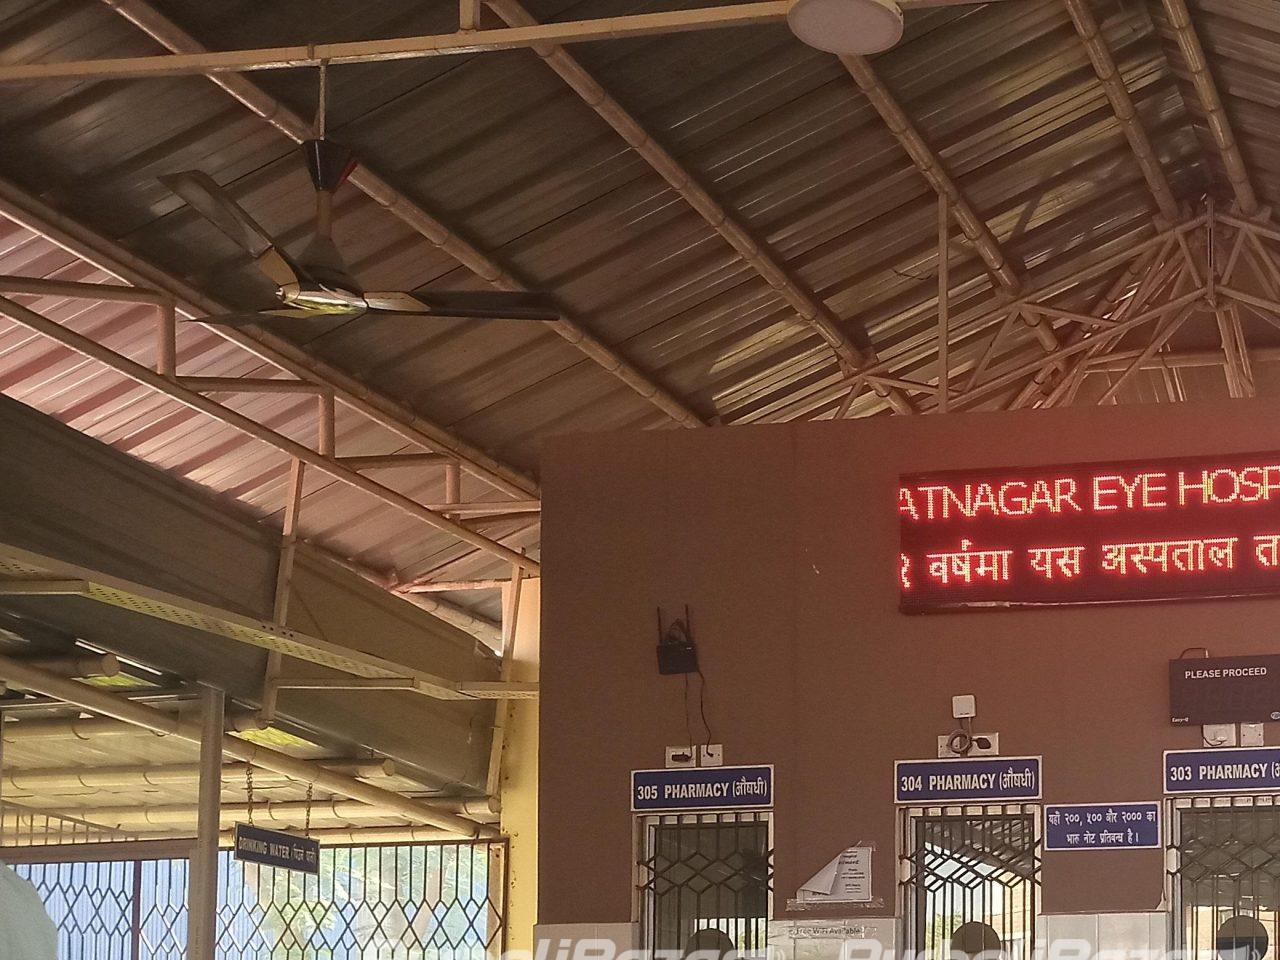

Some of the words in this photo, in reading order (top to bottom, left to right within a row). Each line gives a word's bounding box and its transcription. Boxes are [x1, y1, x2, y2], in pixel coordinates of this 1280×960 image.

[899, 478, 1083, 520] ATNAGAR
[1093, 473, 1167, 510] EYE
[1027, 546, 1085, 579] यस
[1102, 537, 1239, 575] अस्पताल
[1184, 669, 1221, 679] PLEASE
[1222, 667, 1267, 677] PROCEED
[1170, 766, 1192, 781] 303
[1199, 763, 1268, 780] PHARMACY
[637, 785, 658, 800] 305
[664, 782, 729, 799] PHARMACY
[901, 775, 922, 792] 304
[929, 773, 996, 791] PHARMACY
[1122, 811, 1142, 823] २०००
[1146, 811, 1156, 822] का
